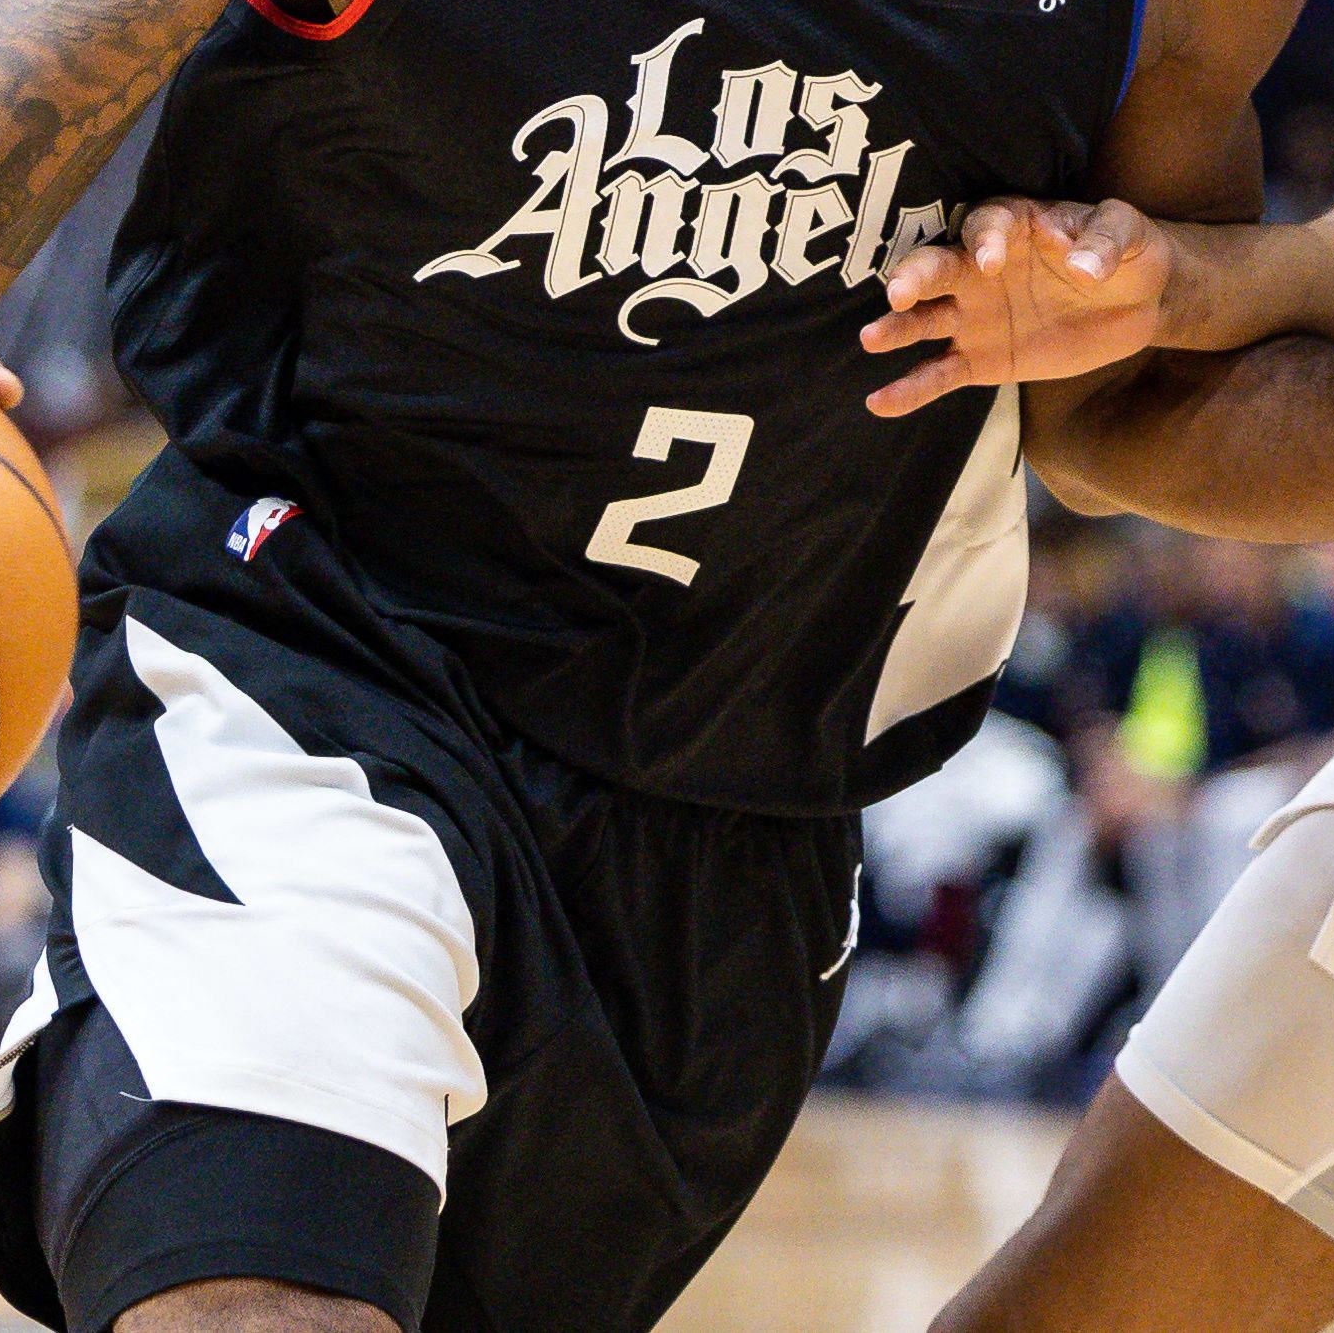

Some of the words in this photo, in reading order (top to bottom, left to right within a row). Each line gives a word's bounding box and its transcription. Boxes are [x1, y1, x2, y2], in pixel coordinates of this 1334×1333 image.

[604, 17, 883, 184] Los
[413, 93, 969, 346] Angele
[585, 405, 755, 587] 2
